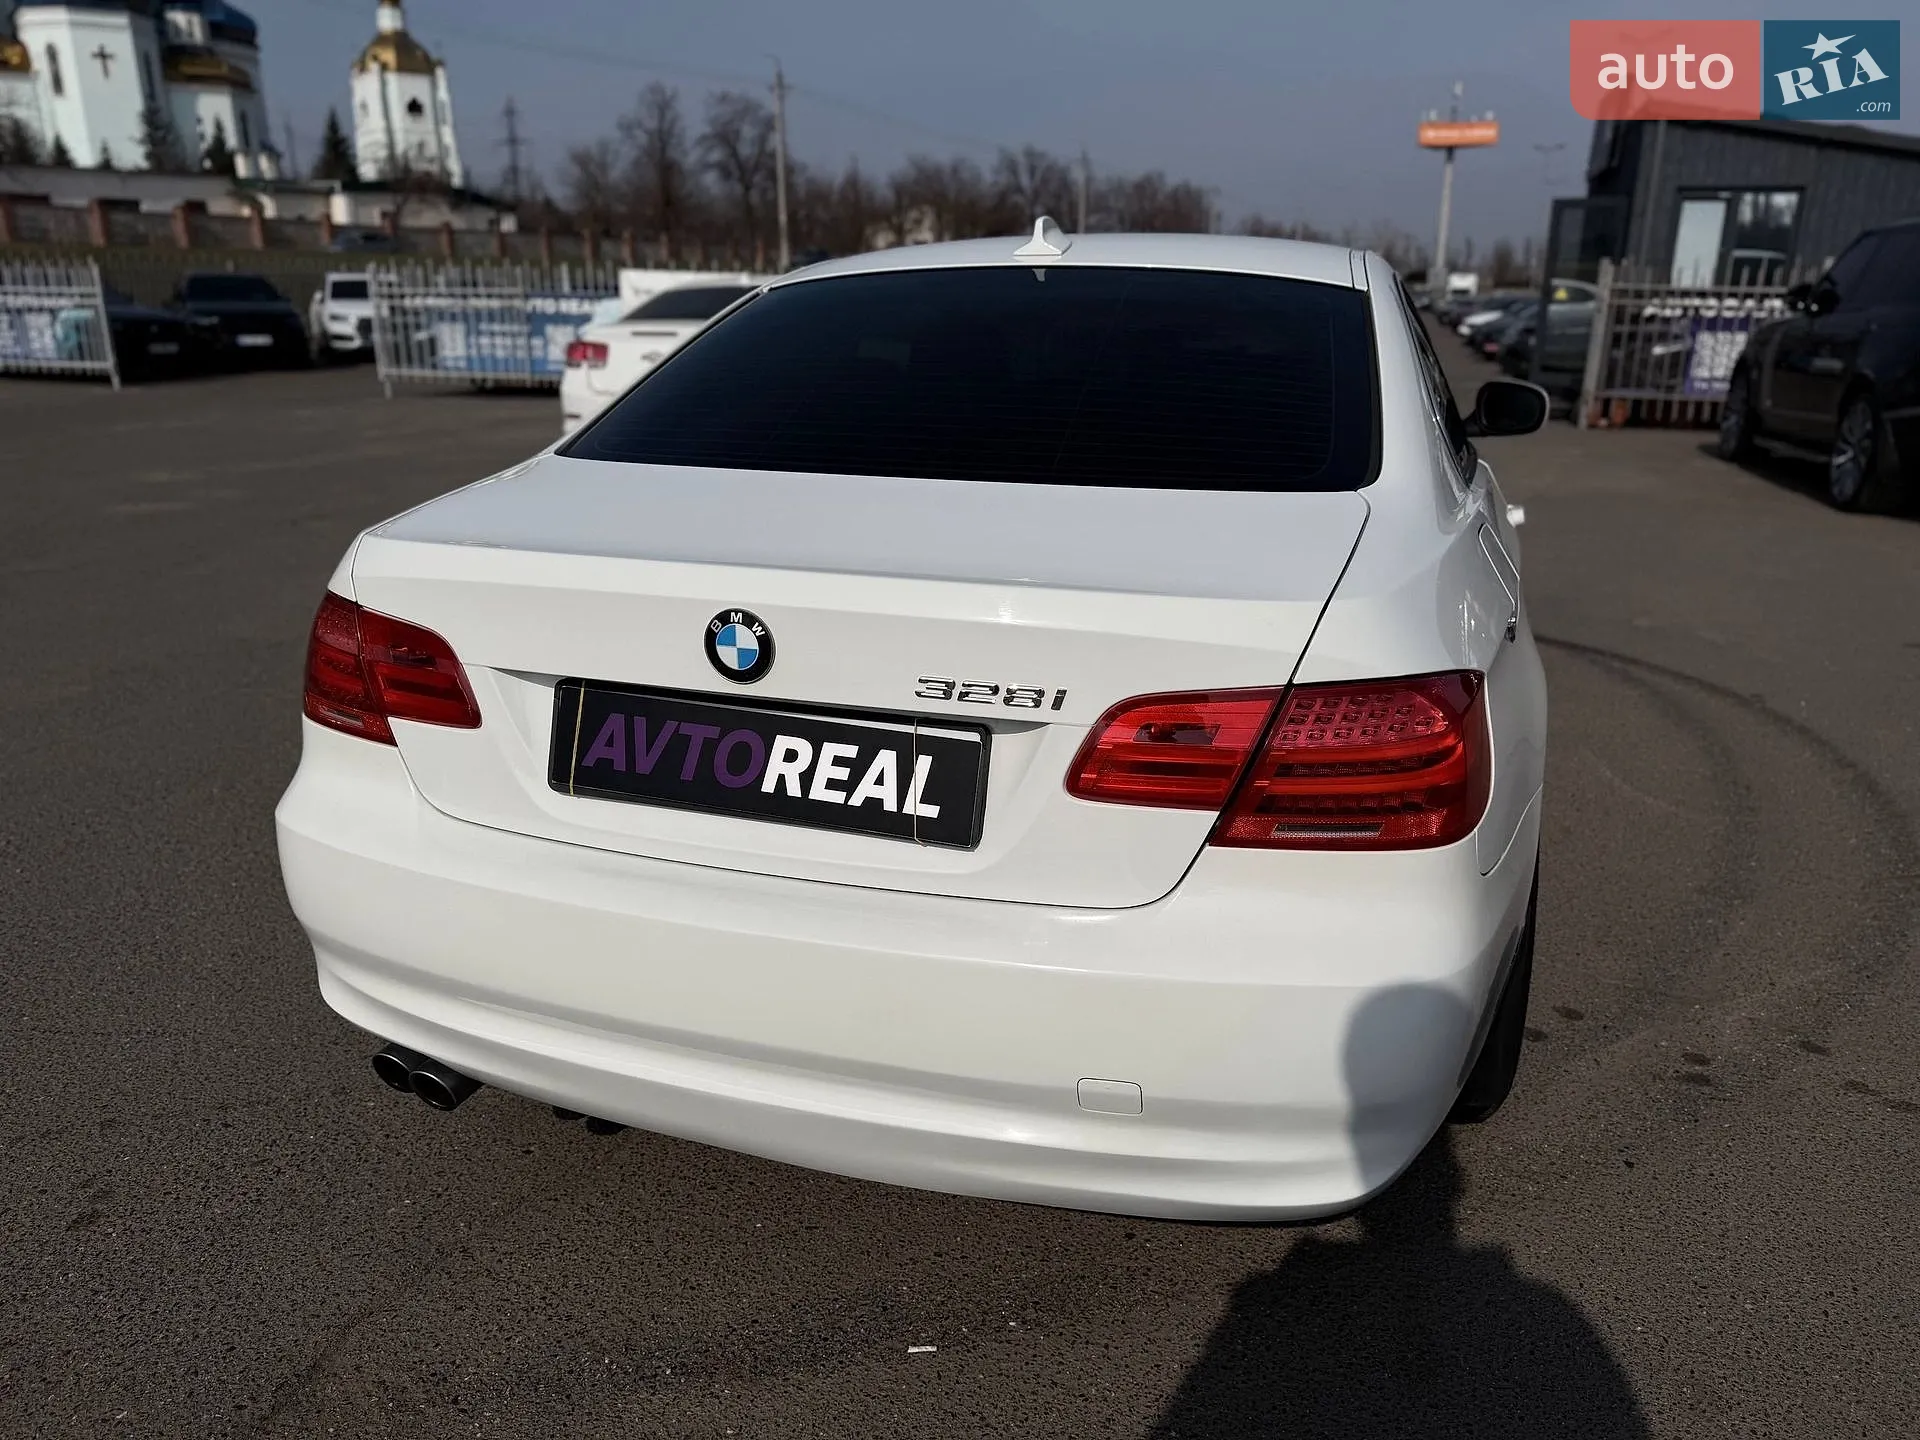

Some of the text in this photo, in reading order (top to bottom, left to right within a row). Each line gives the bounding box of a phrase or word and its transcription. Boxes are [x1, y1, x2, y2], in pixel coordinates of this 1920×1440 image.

[709, 611, 766, 638] BMW
[914, 675, 1069, 712] 328i
[581, 713, 941, 819] AVTOREAL
